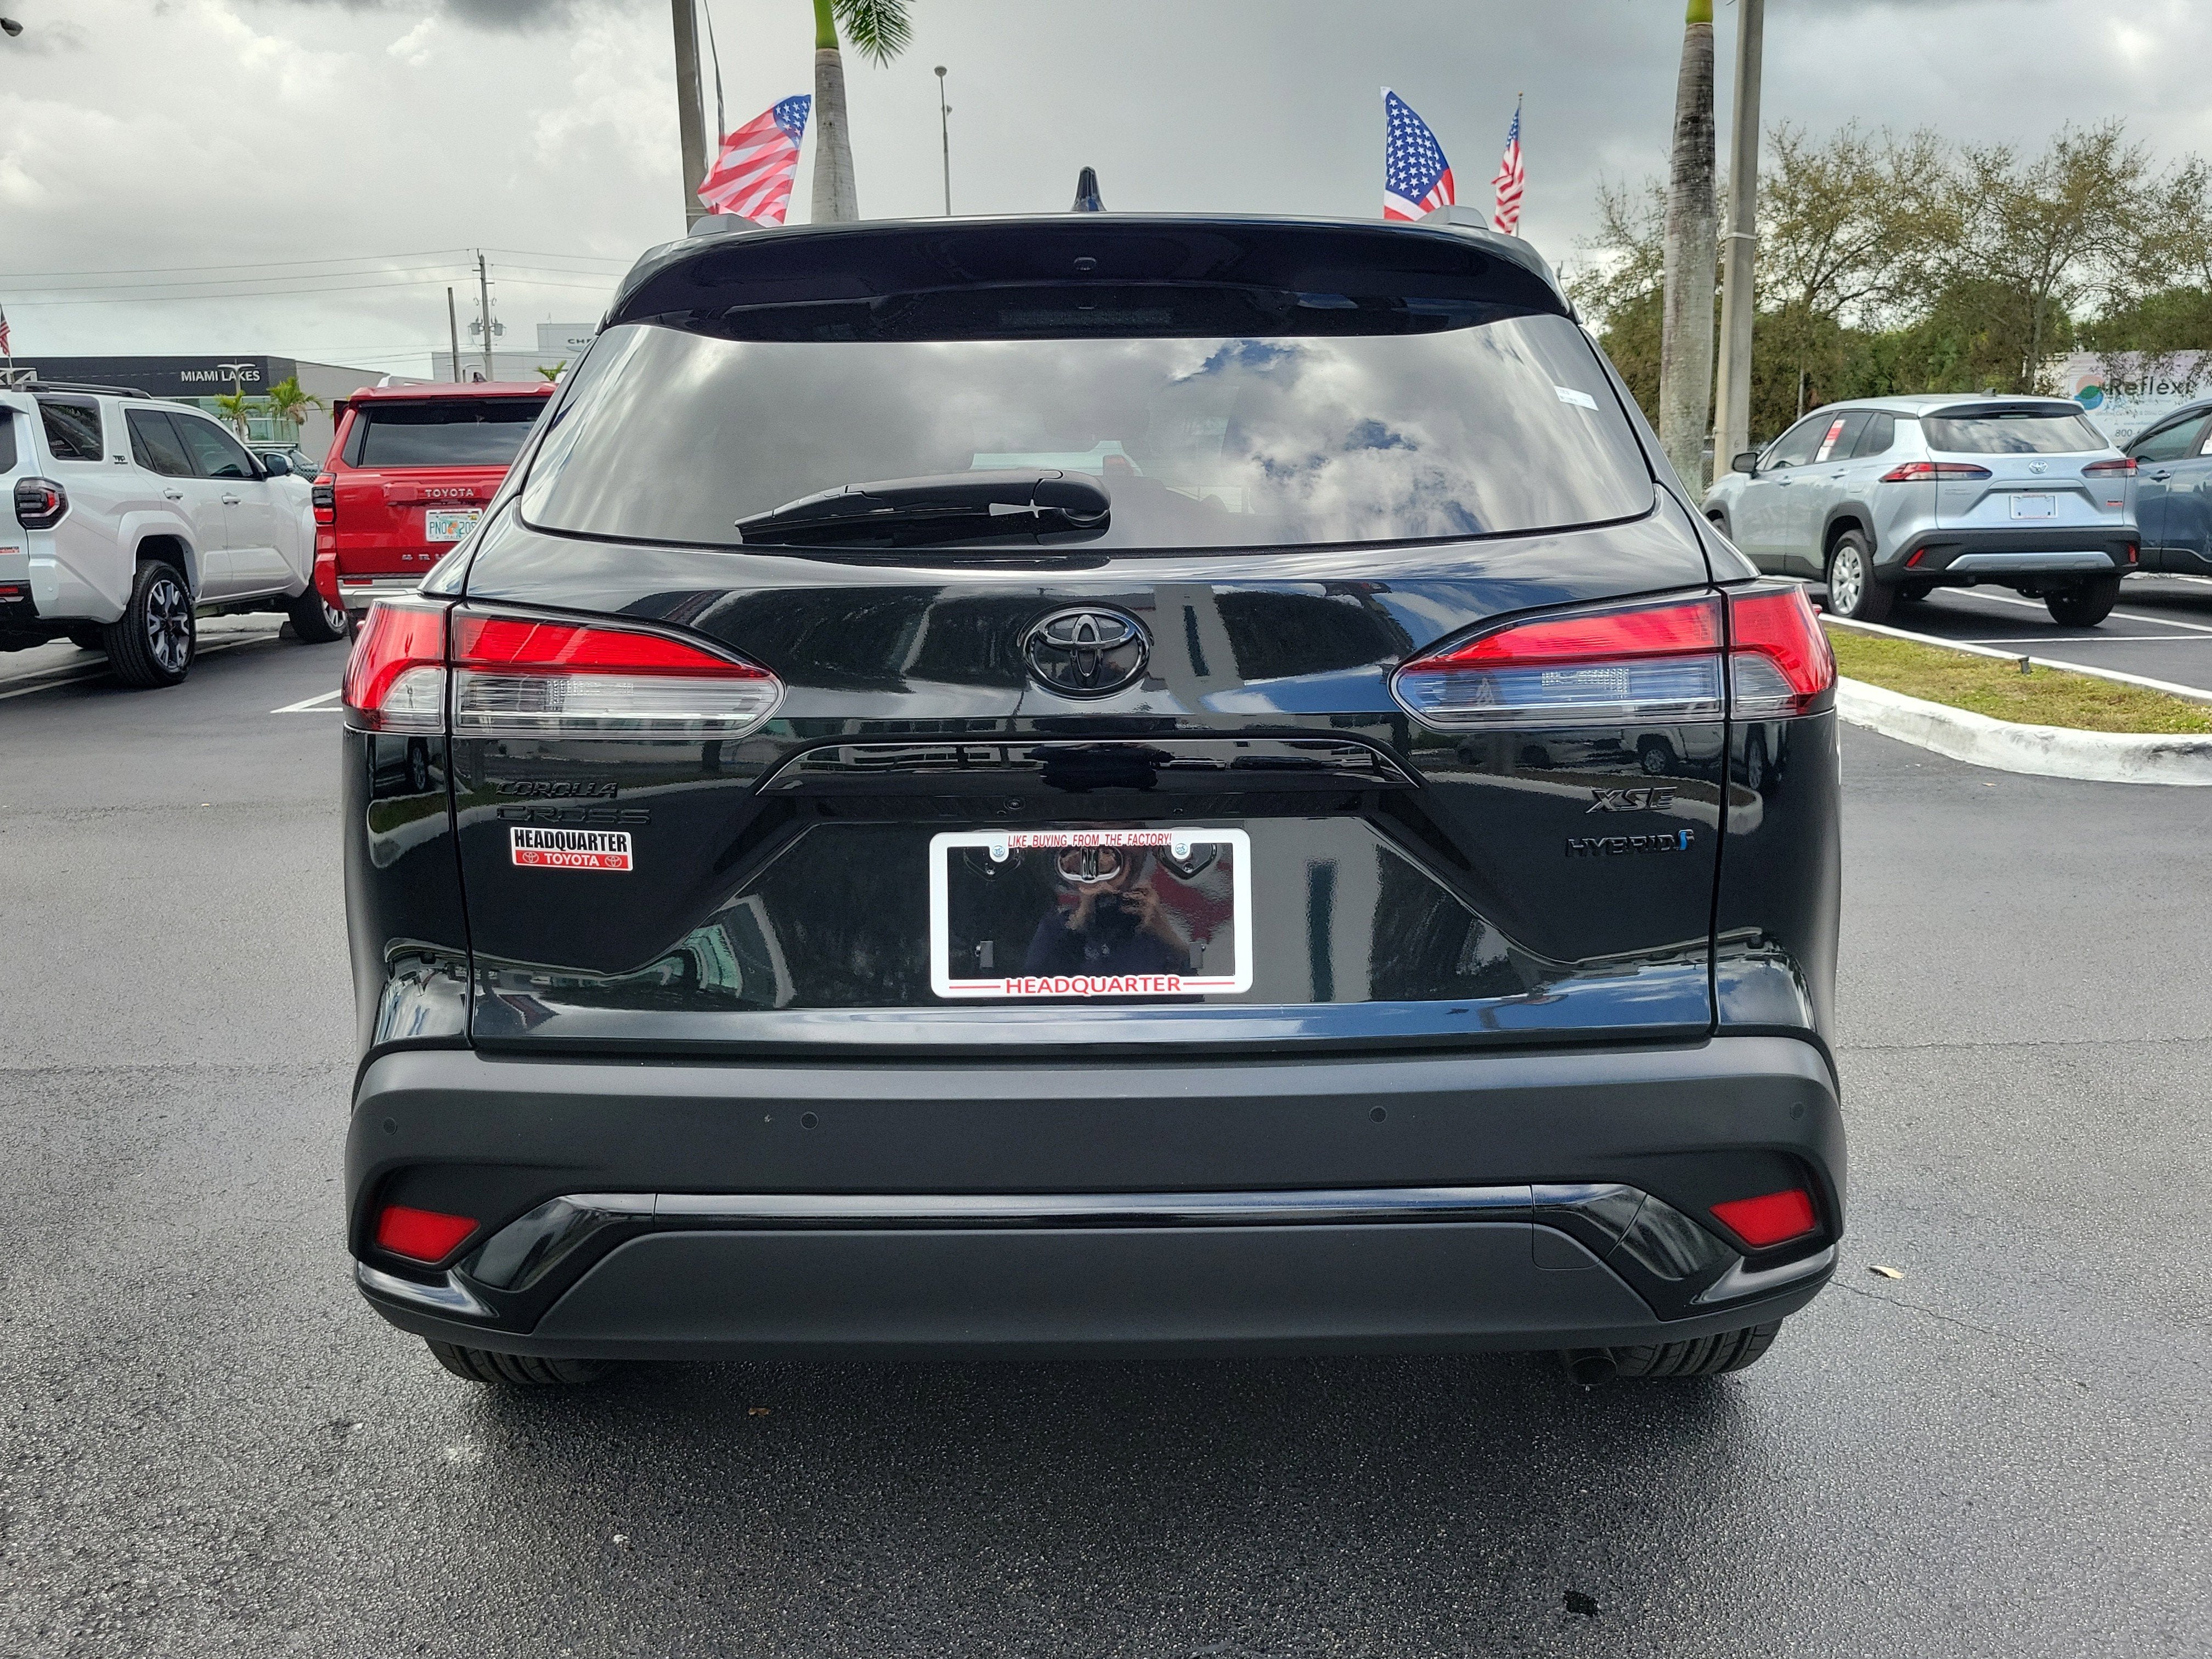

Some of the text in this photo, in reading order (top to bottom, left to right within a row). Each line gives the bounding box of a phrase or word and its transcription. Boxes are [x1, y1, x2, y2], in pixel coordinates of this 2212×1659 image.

[180, 370, 261, 382] MIAMI LAKES
[425, 488, 474, 498] TOYOTA
[495, 781, 619, 798] COROLLA
[1584, 786, 1678, 814] XSE
[496, 805, 652, 824] CROSS
[514, 828, 628, 853] HEADQUARTER
[1008, 833, 1172, 848] LIKE BUYING FROM THE FACTORY!
[1566, 833, 1676, 856] HYBRID
[544, 853, 600, 866] TOYOTA
[1006, 977, 1182, 995] HEADQUARTER
